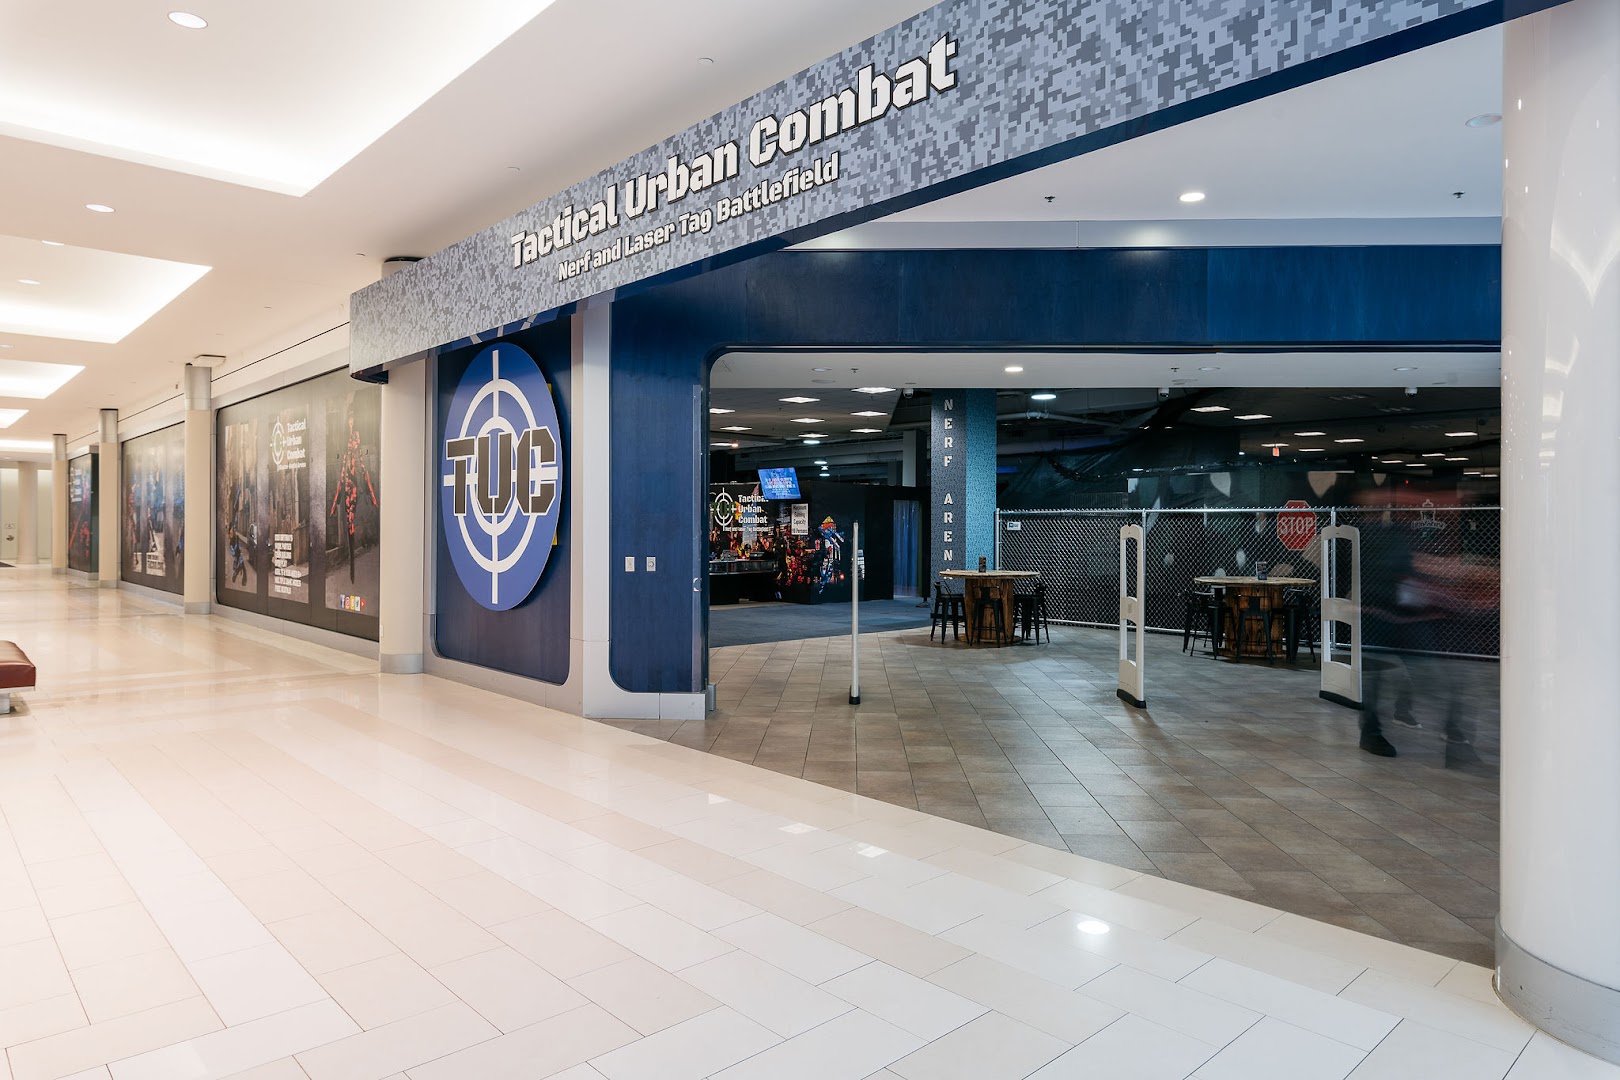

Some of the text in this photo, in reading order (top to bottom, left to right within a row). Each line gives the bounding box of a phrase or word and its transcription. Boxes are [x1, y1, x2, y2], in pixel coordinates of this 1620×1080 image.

[511, 32, 958, 269] Tactical Urban Combat
[557, 151, 840, 282] Nerf and Laser Tag Battlefield
[944, 399, 954, 467] NERF
[446, 425, 556, 516] TUC
[738, 504, 762, 513] Urban
[738, 515, 768, 524] Combat
[1280, 516, 1314, 535] STOP
